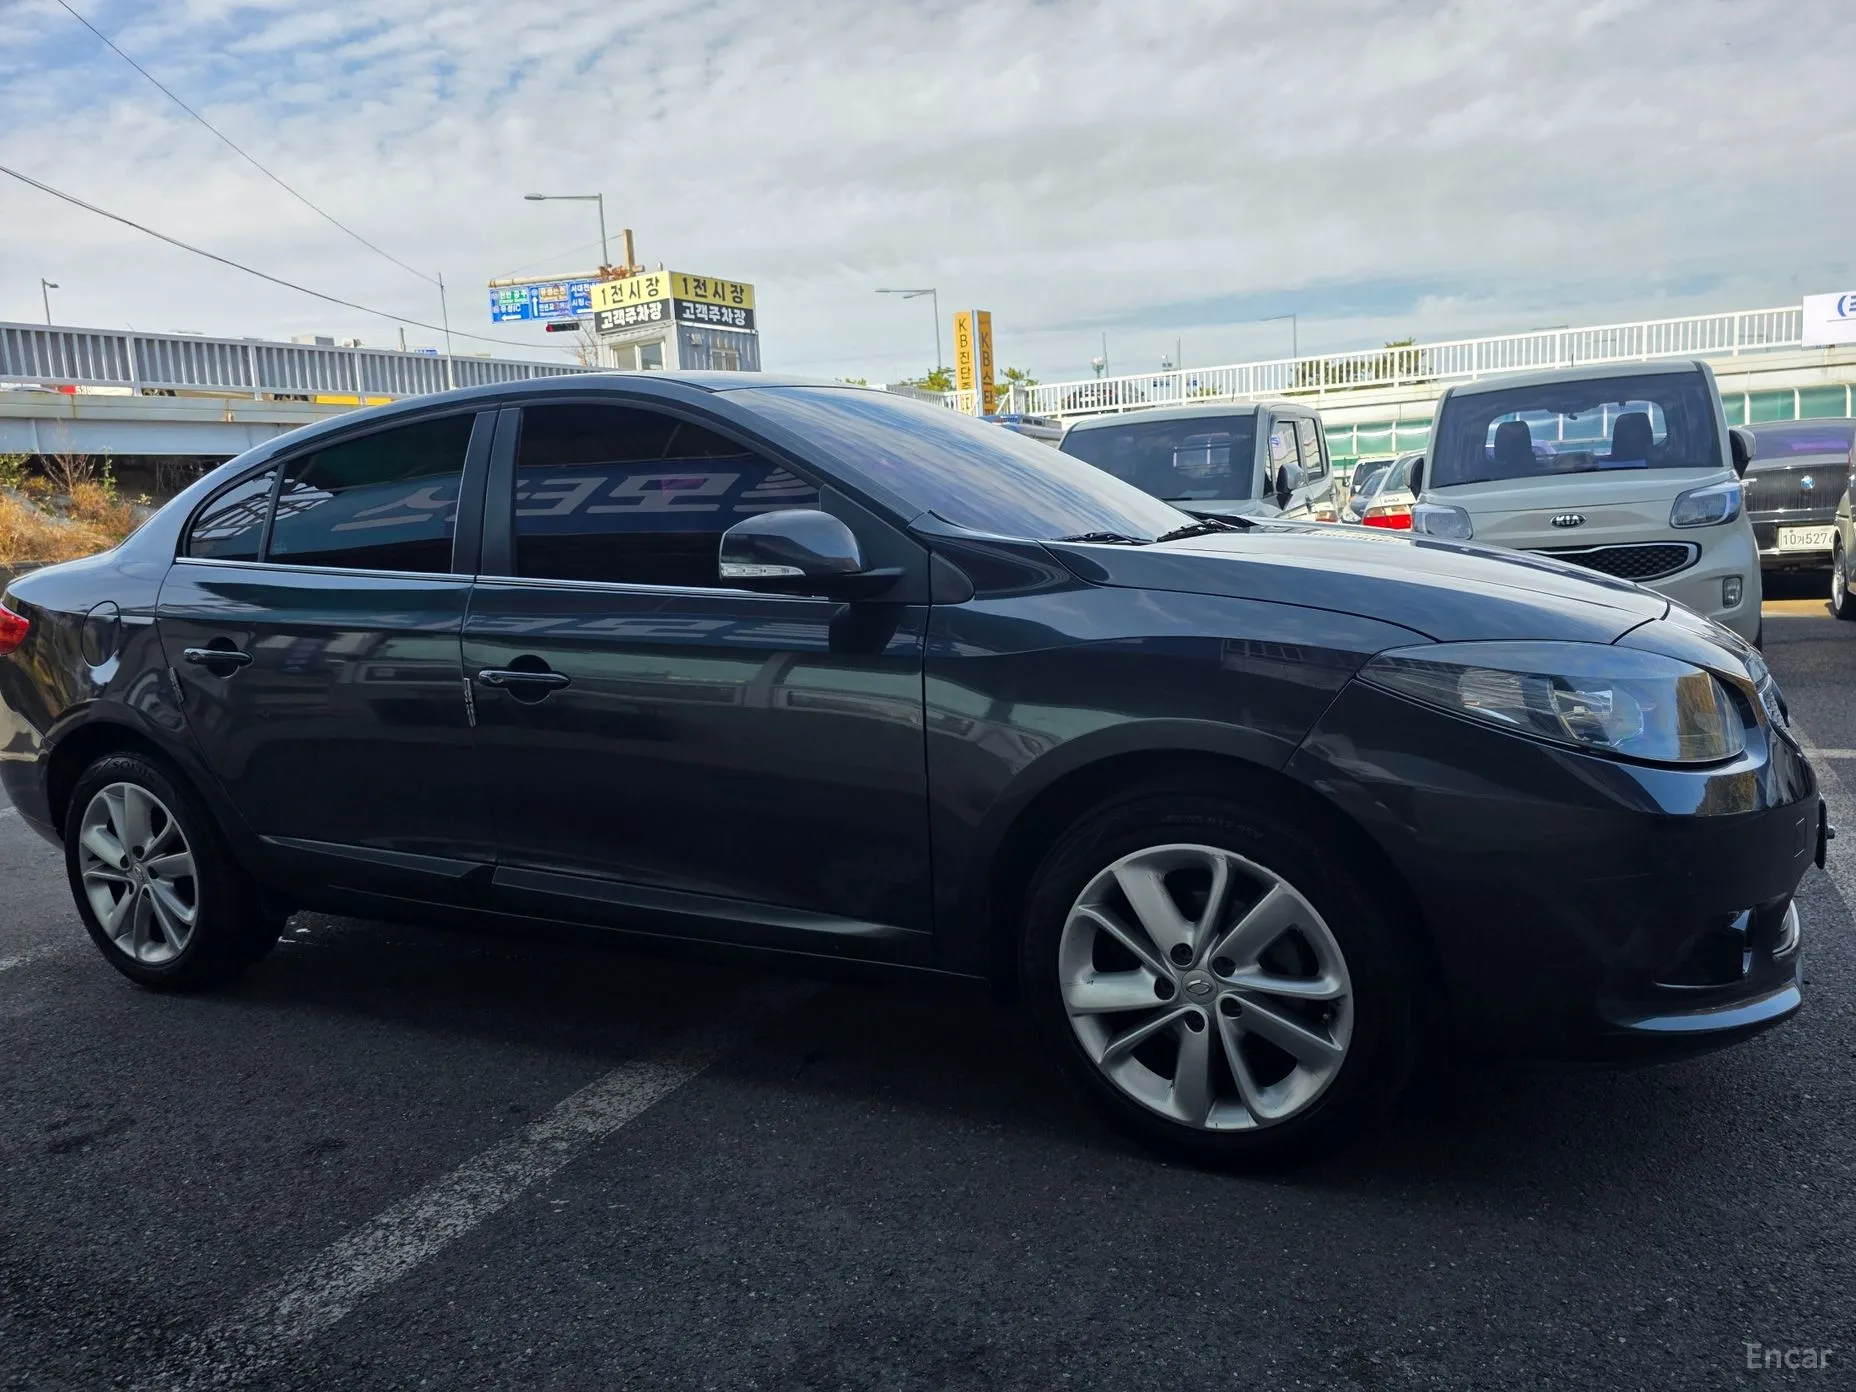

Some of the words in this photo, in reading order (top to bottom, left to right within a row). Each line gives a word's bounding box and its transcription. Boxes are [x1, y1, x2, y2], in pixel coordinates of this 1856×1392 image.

[601, 276, 660, 306] 1전시장
[682, 277, 745, 304] 1전시장
[601, 301, 662, 329] 고객주차장
[682, 302, 746, 326] 고객주차장
[1556, 515, 1579, 525] KIA
